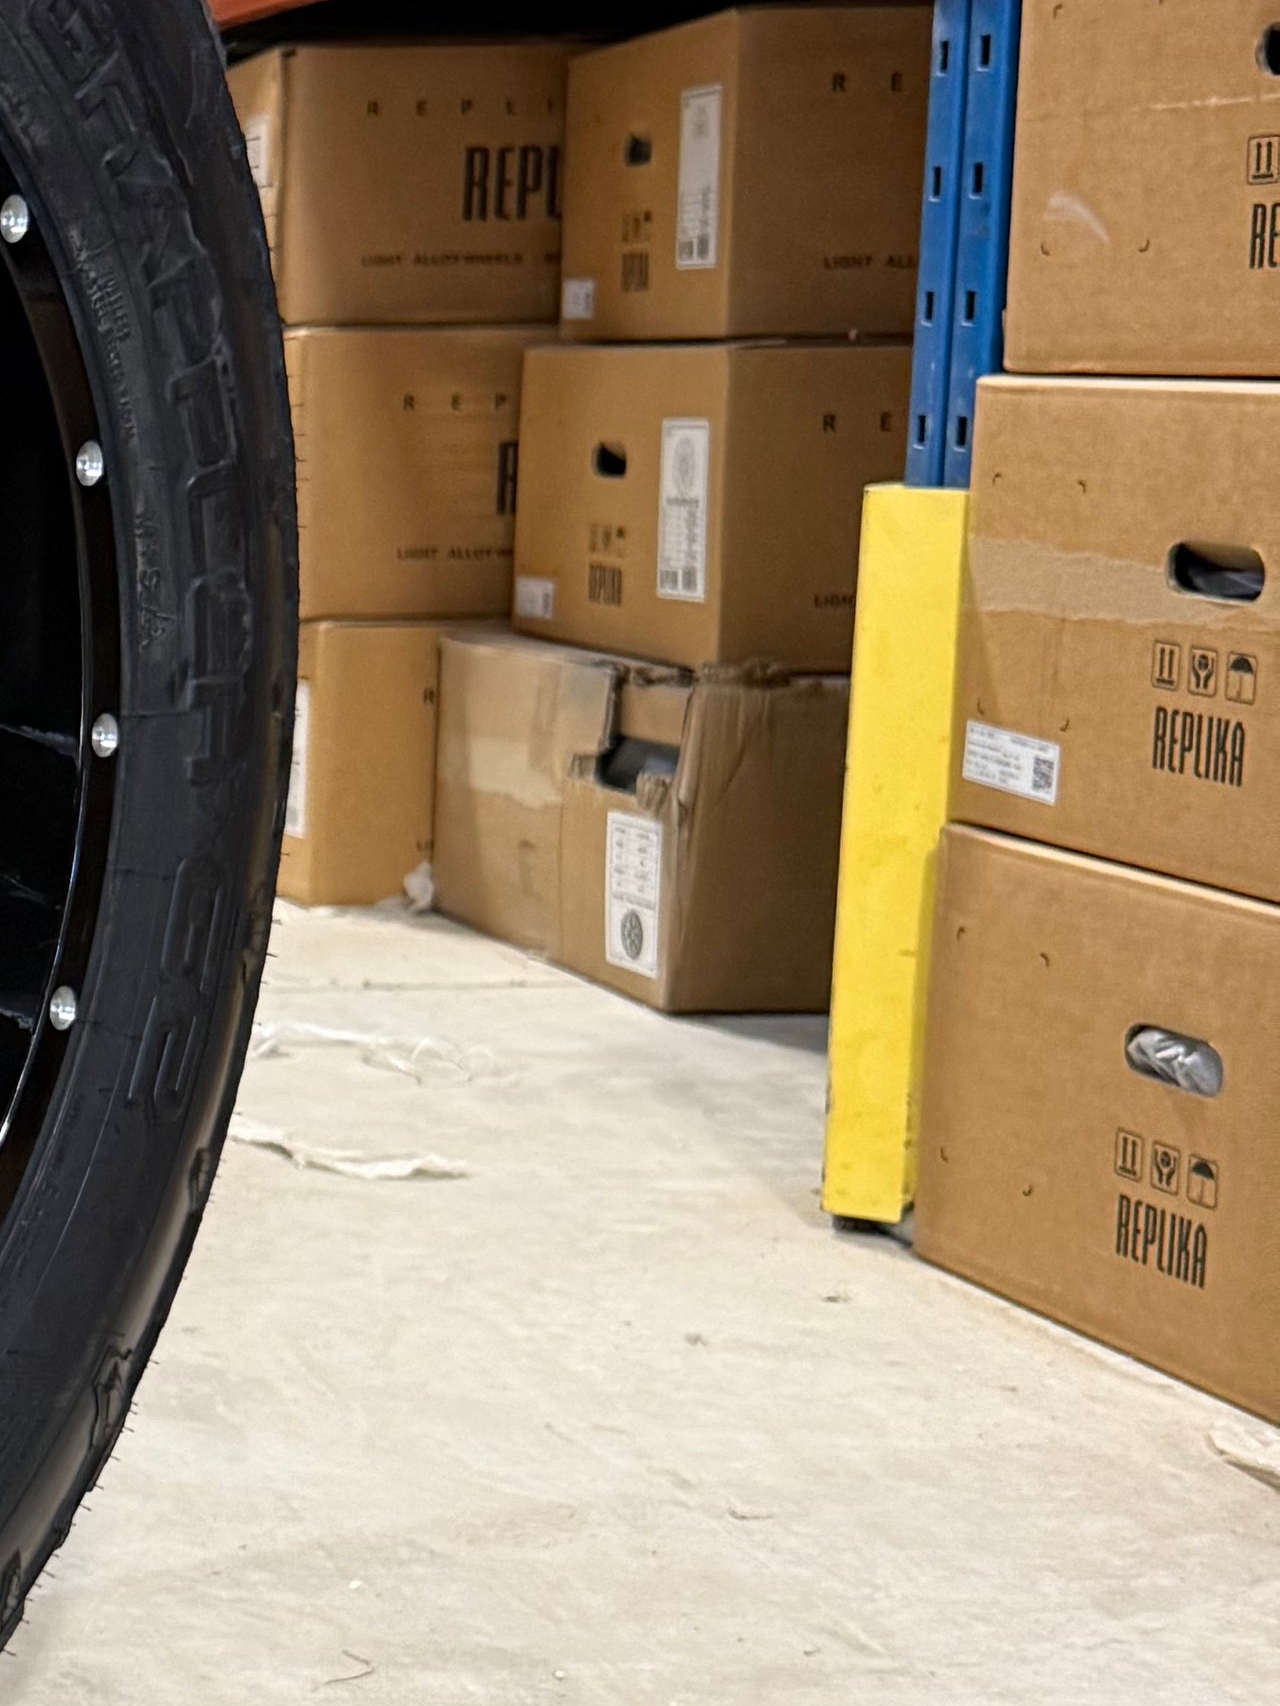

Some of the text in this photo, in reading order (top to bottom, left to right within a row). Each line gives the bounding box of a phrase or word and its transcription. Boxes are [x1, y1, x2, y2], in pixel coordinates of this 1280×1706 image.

[367, 100, 553, 117] REPLI
[463, 146, 561, 222] REPL
[885, 256, 918, 269] ALL
[814, 594, 855, 608] LIGH
[1152, 706, 1245, 787] REPLIKA
[1115, 1193, 1208, 1290] REPLIKA
